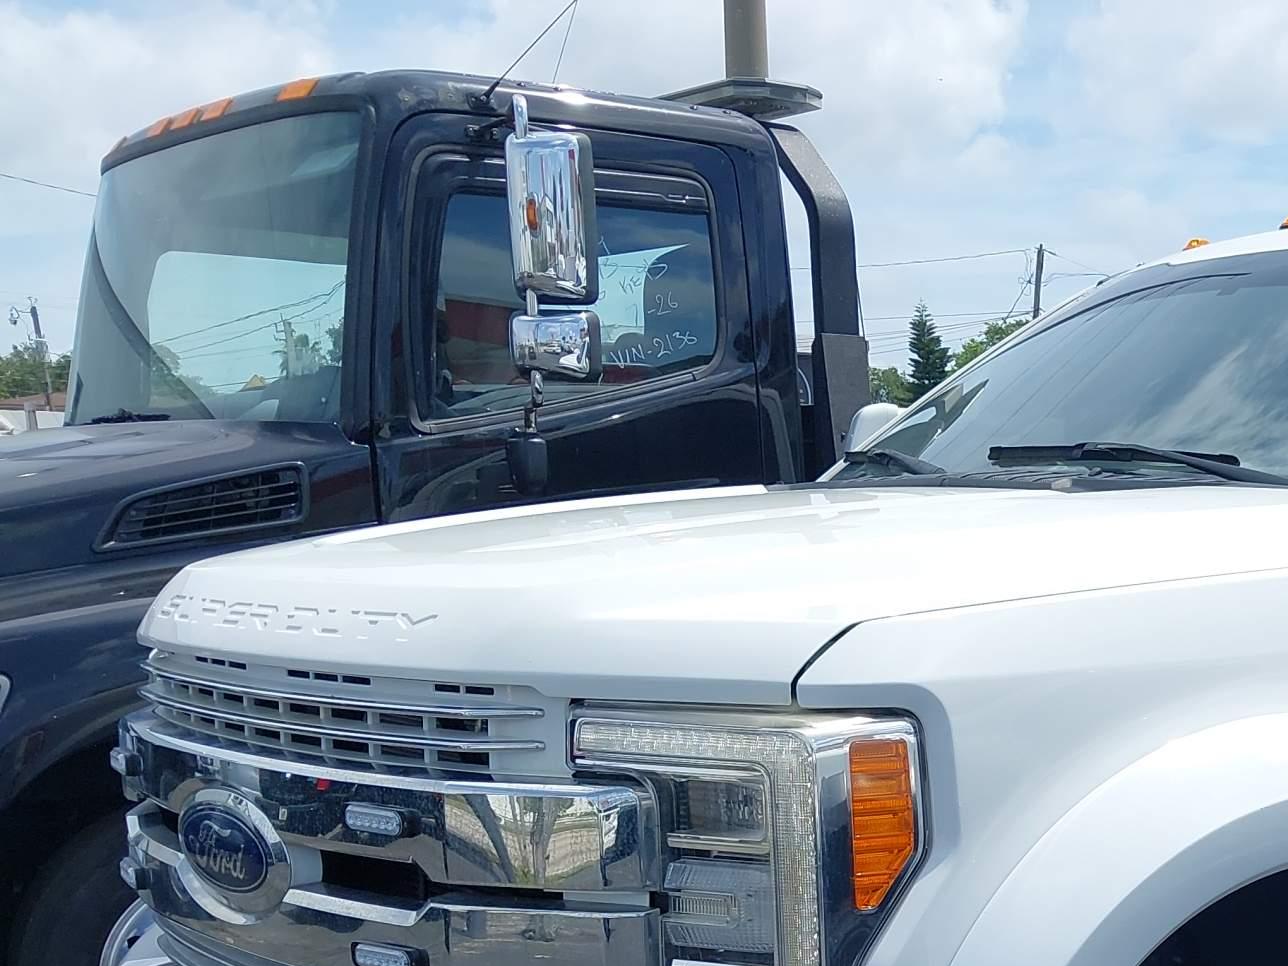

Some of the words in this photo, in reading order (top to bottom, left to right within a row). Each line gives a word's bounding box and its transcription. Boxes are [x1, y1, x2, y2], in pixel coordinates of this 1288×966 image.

[157, 593, 280, 630] SUPER
[275, 605, 439, 643] DUTY
[188, 820, 246, 880] Ford
